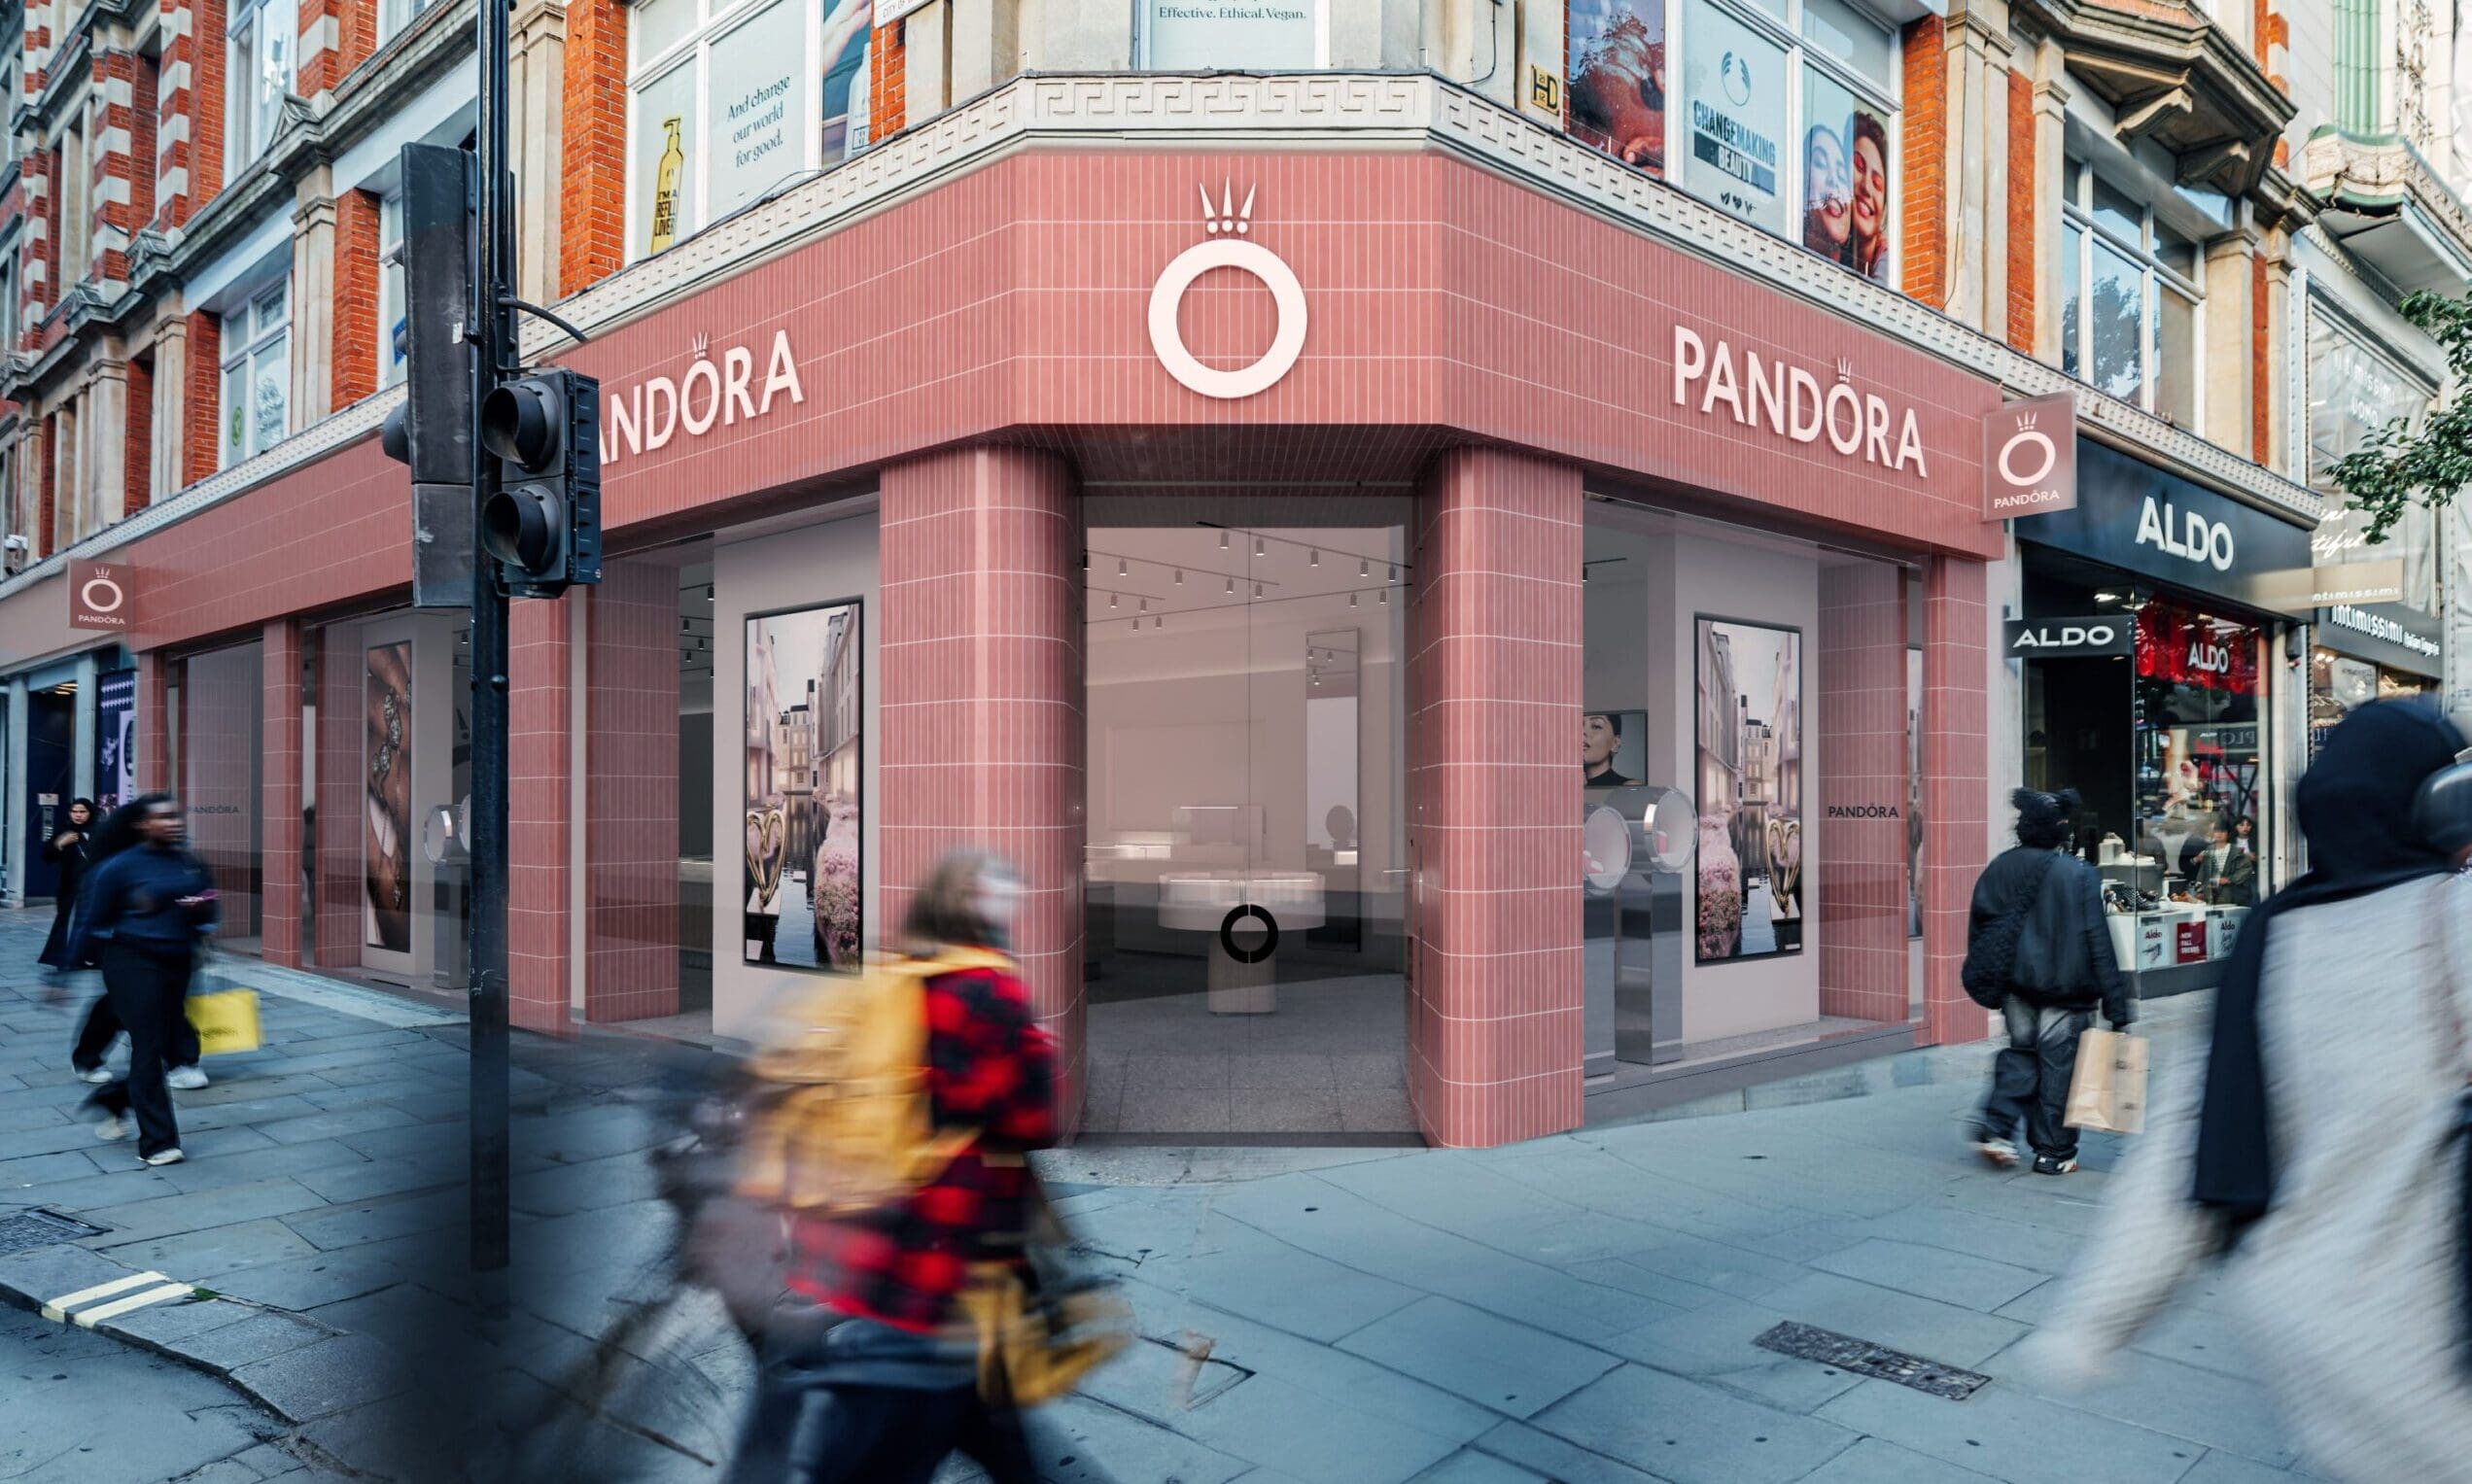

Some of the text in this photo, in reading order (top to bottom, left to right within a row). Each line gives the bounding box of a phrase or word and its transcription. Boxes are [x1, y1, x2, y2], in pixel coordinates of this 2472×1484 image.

[1159, 7, 1306, 20] Effective. Ethical. Vegan.
[727, 76, 789, 122] And change
[733, 100, 783, 144] our world
[1693, 99, 1776, 167] CHANGEMAKING
[736, 128, 783, 168] for good.
[599, 329, 804, 466] NDORA
[1675, 324, 1928, 478] PANDORA
[1994, 489, 2060, 510] PANDORA
[2135, 496, 2234, 571] ALDO
[78, 614, 125, 625] PANDORA
[2012, 625, 2115, 649] ALDO
[2332, 603, 2402, 645] intimissimi
[2187, 640, 2229, 674] ALDO
[1828, 802, 1899, 818] PANDORA
